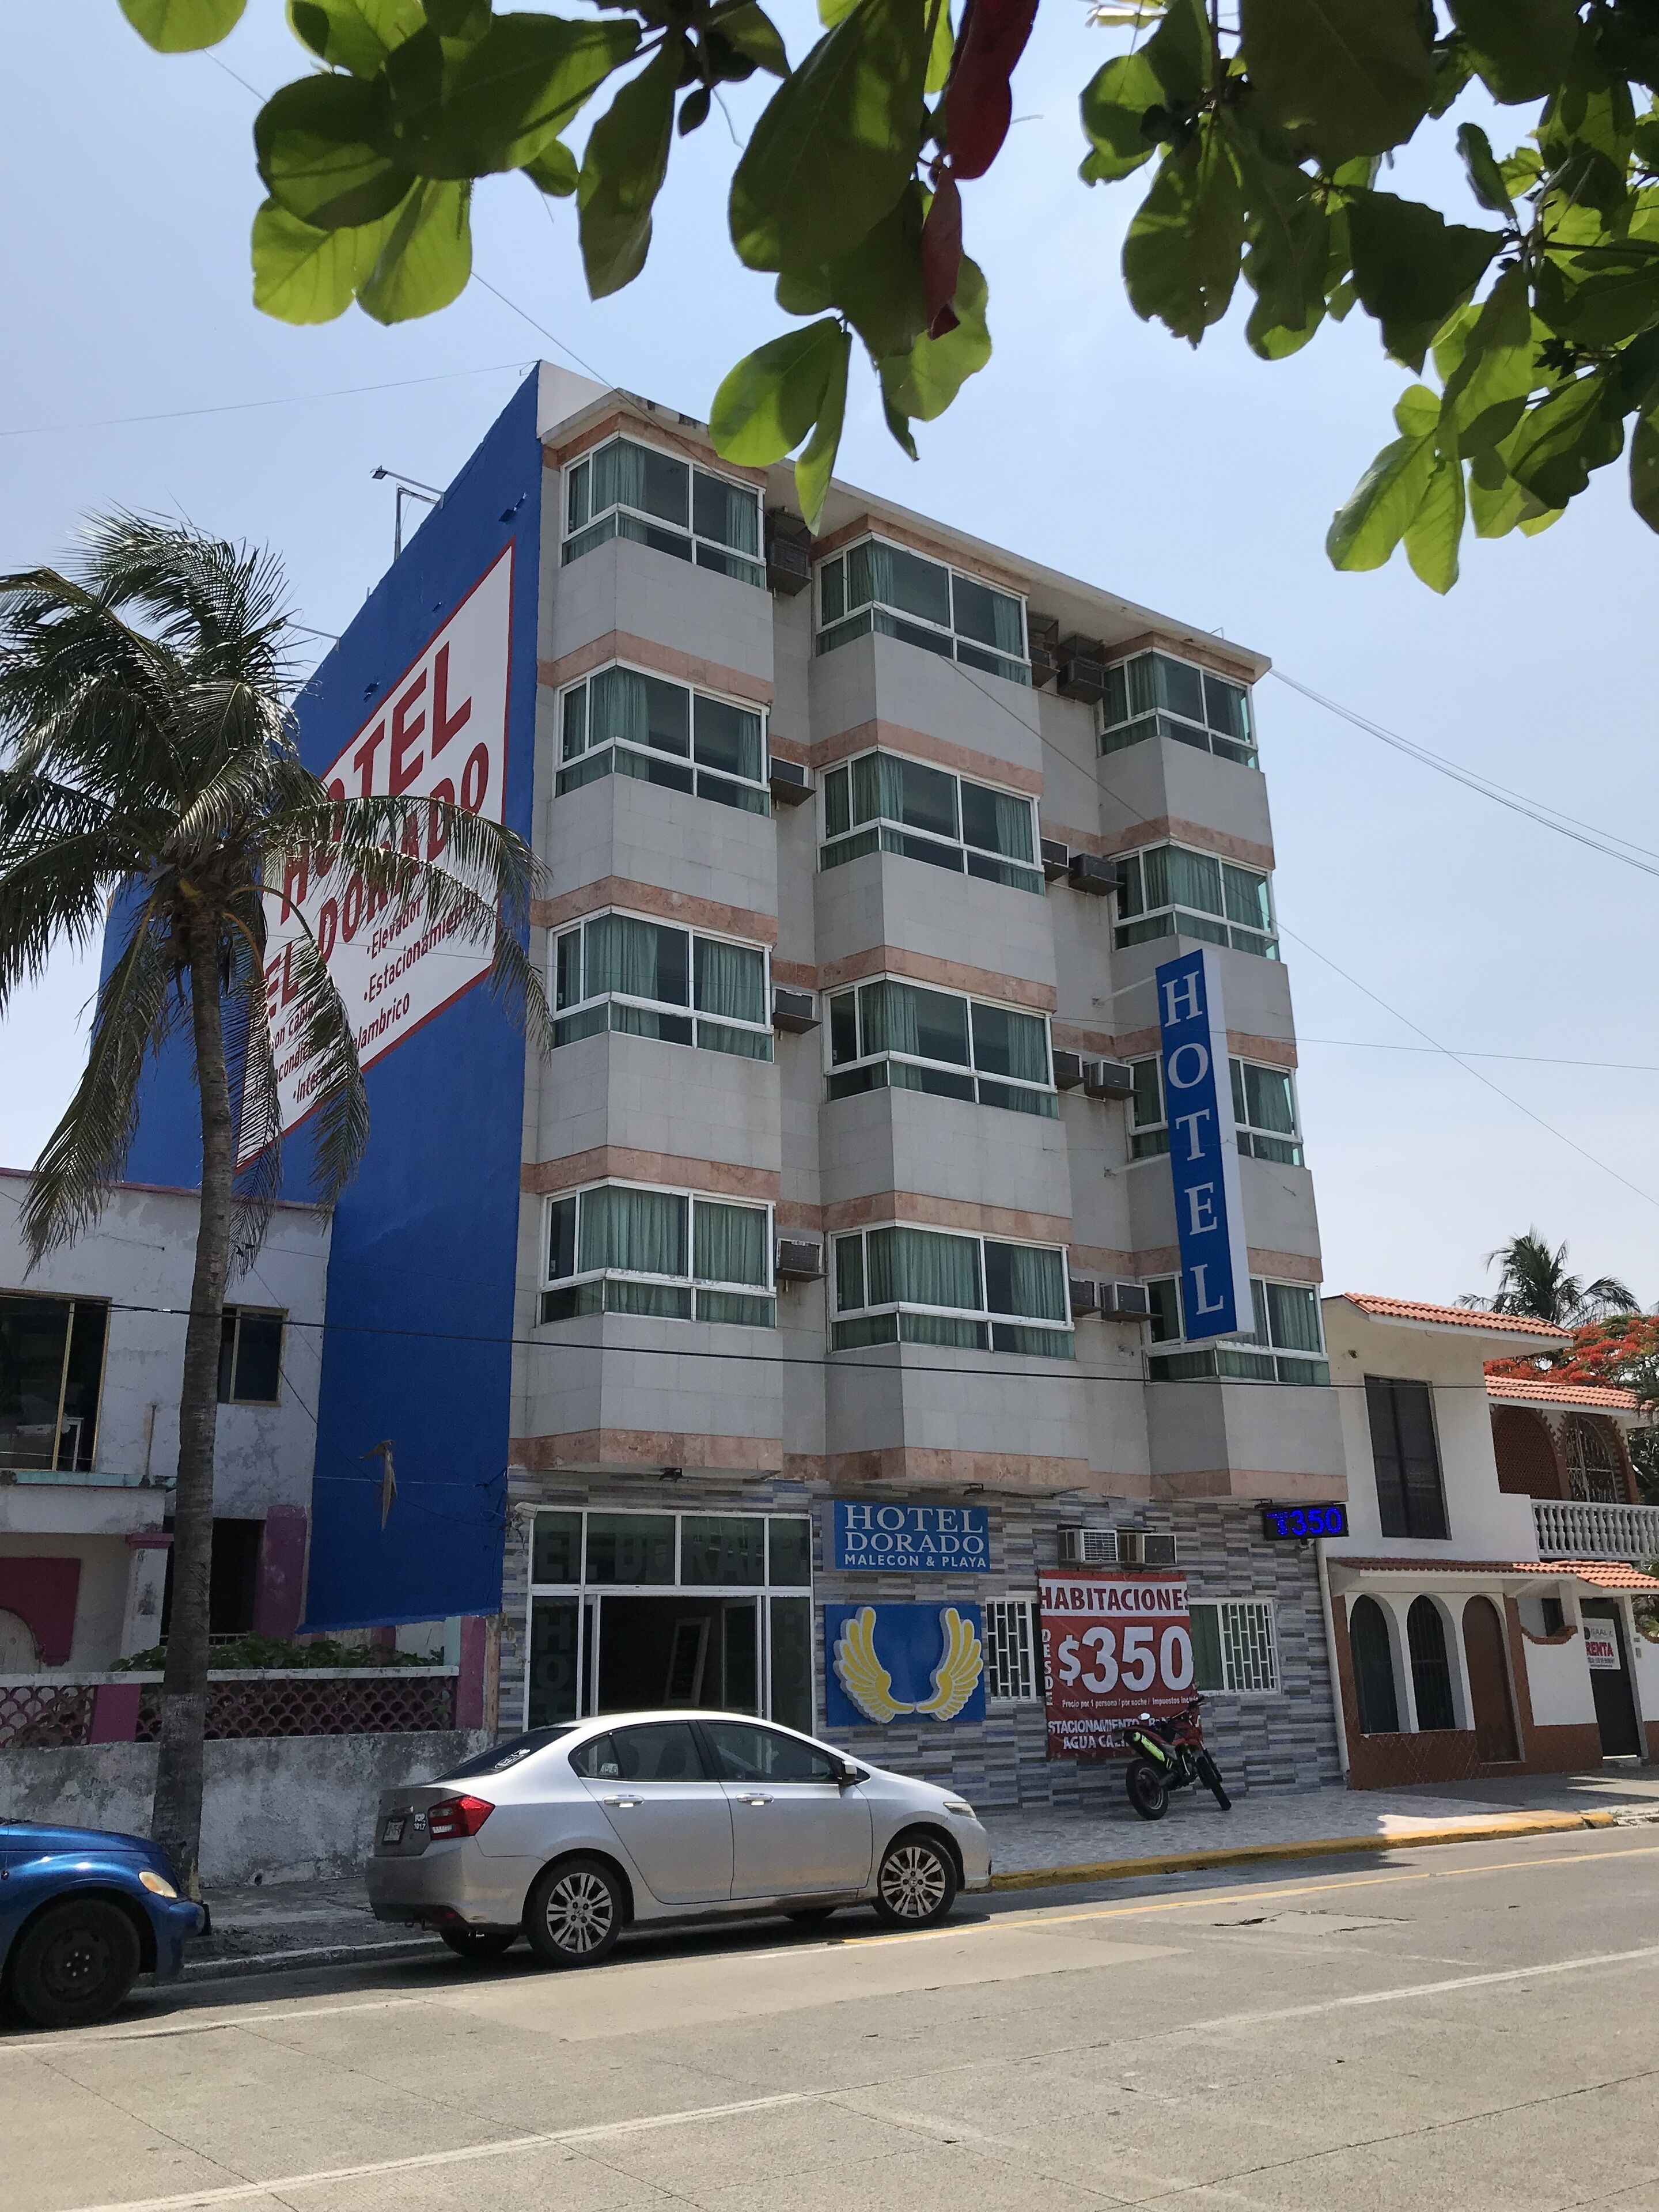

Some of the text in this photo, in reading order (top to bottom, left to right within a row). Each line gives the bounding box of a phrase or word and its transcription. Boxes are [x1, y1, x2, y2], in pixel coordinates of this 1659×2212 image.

[371, 895, 423, 960] Elevador
[1162, 970, 1225, 1316] HOTEL
[844, 1504, 983, 1534] HOTEL
[844, 1531, 984, 1555] DORADO
[844, 1554, 986, 1568] MALECON & PLAYA
[1057, 1626, 1194, 1694] $350
[1585, 1641, 1613, 1657] RENTA
[1041, 1628, 1054, 1706] DESDE
[1062, 1699, 1080, 1708] Precio
[1081, 1700, 1089, 1709] por
[1095, 1700, 1118, 1709] persona
[1121, 1699, 1130, 1708] por
[1131, 1698, 1147, 1706] noche
[1153, 1696, 1180, 1706] Impuestos
[1063, 1735, 1097, 1750] AGUA
